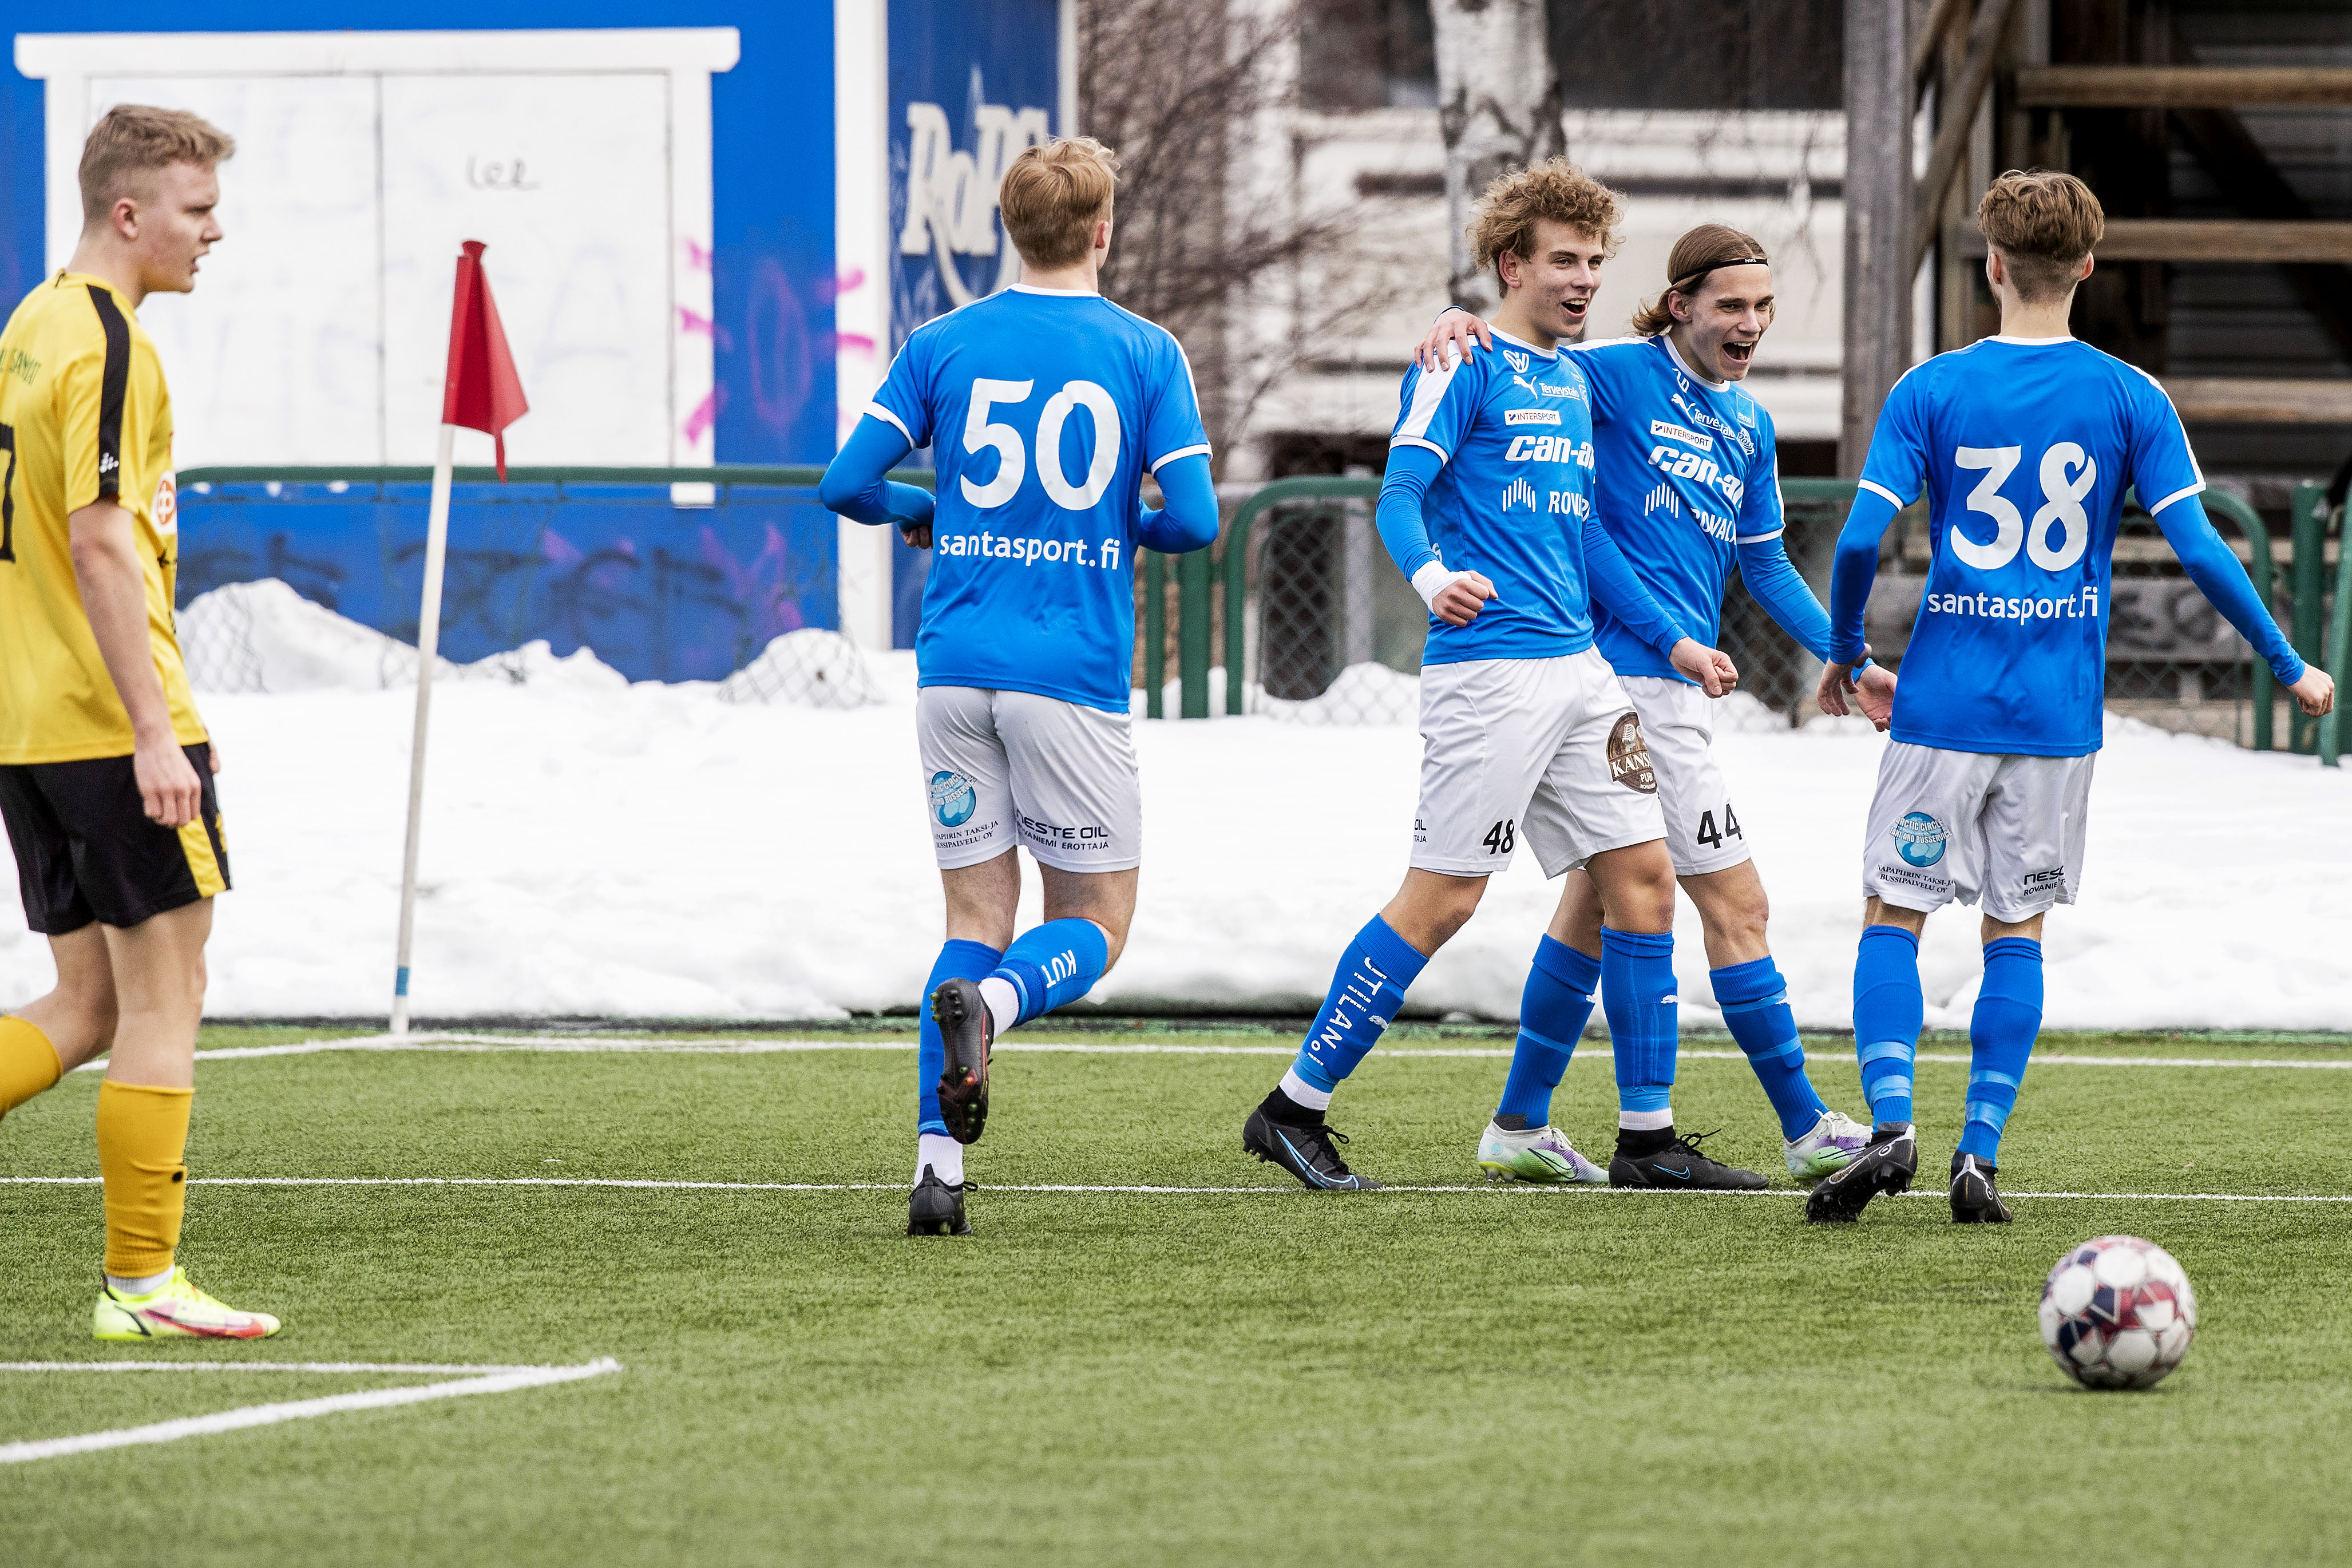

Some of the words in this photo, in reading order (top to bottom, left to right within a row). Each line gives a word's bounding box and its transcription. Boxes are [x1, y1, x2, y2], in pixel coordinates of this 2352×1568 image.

[1517, 413, 1557, 422] INTERSPORT
[1694, 408, 1736, 438] Tervetalo
[960, 378, 1120, 511] 50
[1663, 426, 1710, 447] INTERSPORT
[1951, 442, 2097, 572] 38
[940, 531, 1120, 570] santasport.fi
[1927, 586, 2098, 625] santasport.fi
[1611, 752, 1652, 778] KANS
[944, 769, 964, 790] CIRCLE
[1640, 772, 1653, 783] PUB
[1080, 826, 1108, 839] OIL
[1697, 803, 1743, 849] 44
[1895, 815, 1919, 831] ARCTIC
[1920, 818, 1945, 831] CIRCLE
[983, 830, 994, 840] OY
[1062, 841, 1110, 850] EROTTAJA
[1482, 818, 1515, 855] 48
[1889, 826, 1902, 839] TAXI
[1902, 832, 1915, 844] AND
[1880, 873, 1935, 890] BUSSIPALVELU
[2024, 881, 2058, 896] ROVANIE
[1041, 949, 1076, 989] KUT
